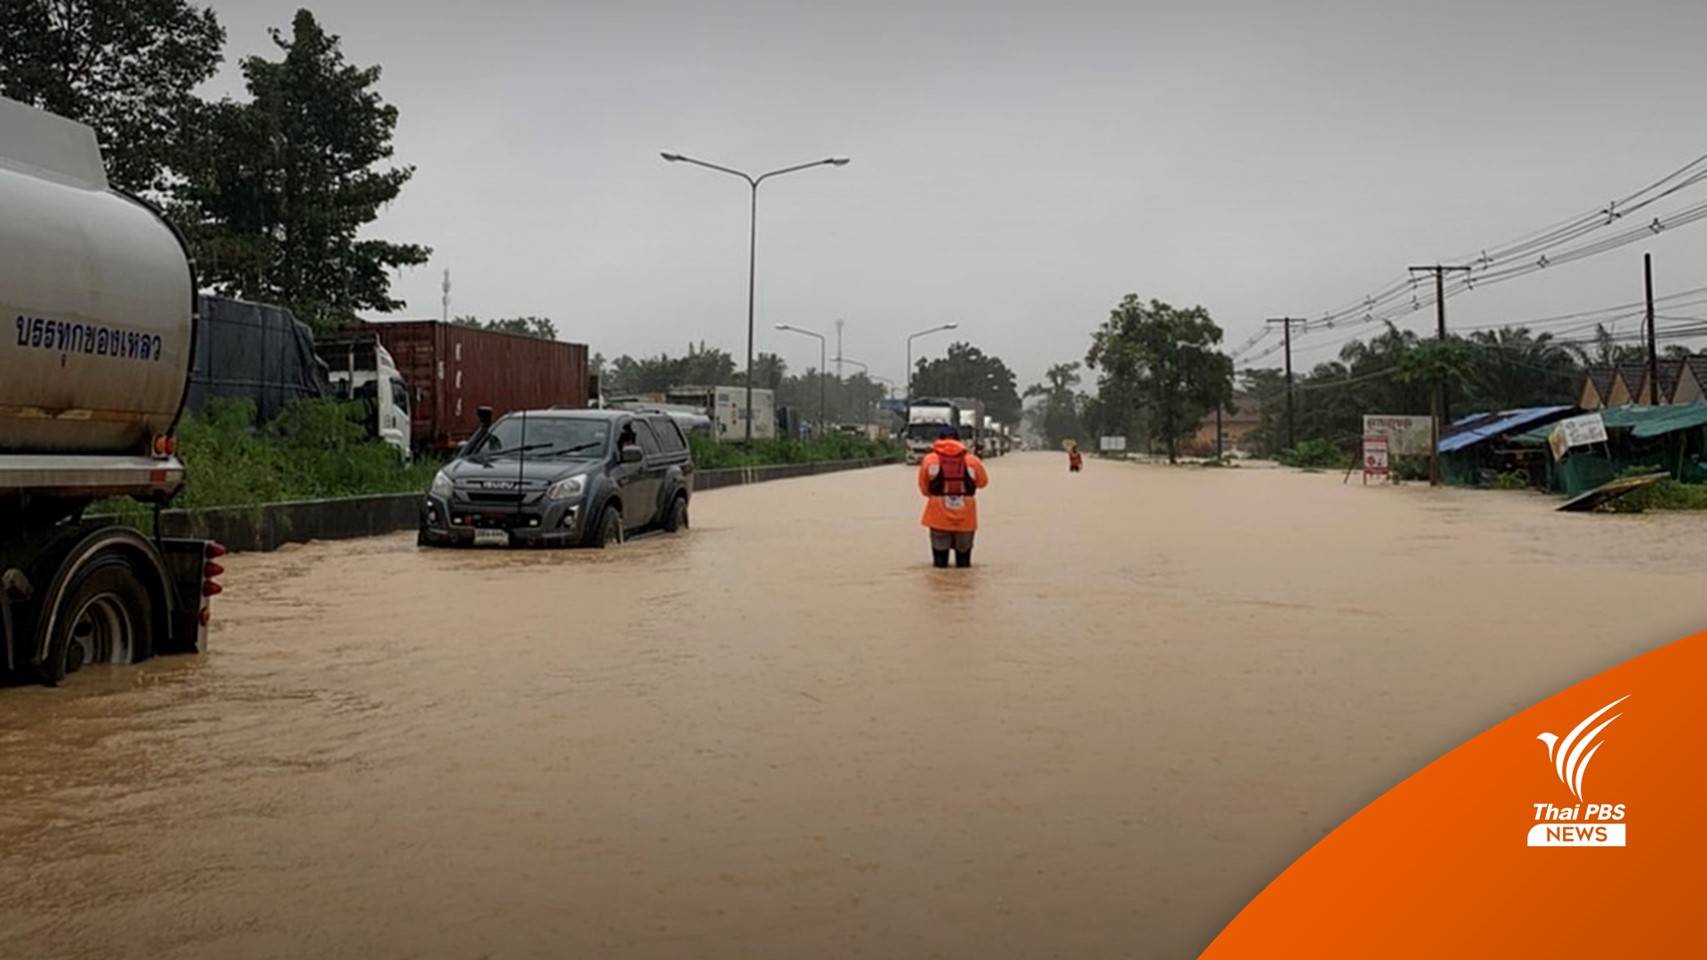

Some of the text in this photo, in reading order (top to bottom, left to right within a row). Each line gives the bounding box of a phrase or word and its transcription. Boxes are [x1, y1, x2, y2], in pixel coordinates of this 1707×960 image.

[15, 315, 162, 368] บรรทุกของเหลว
